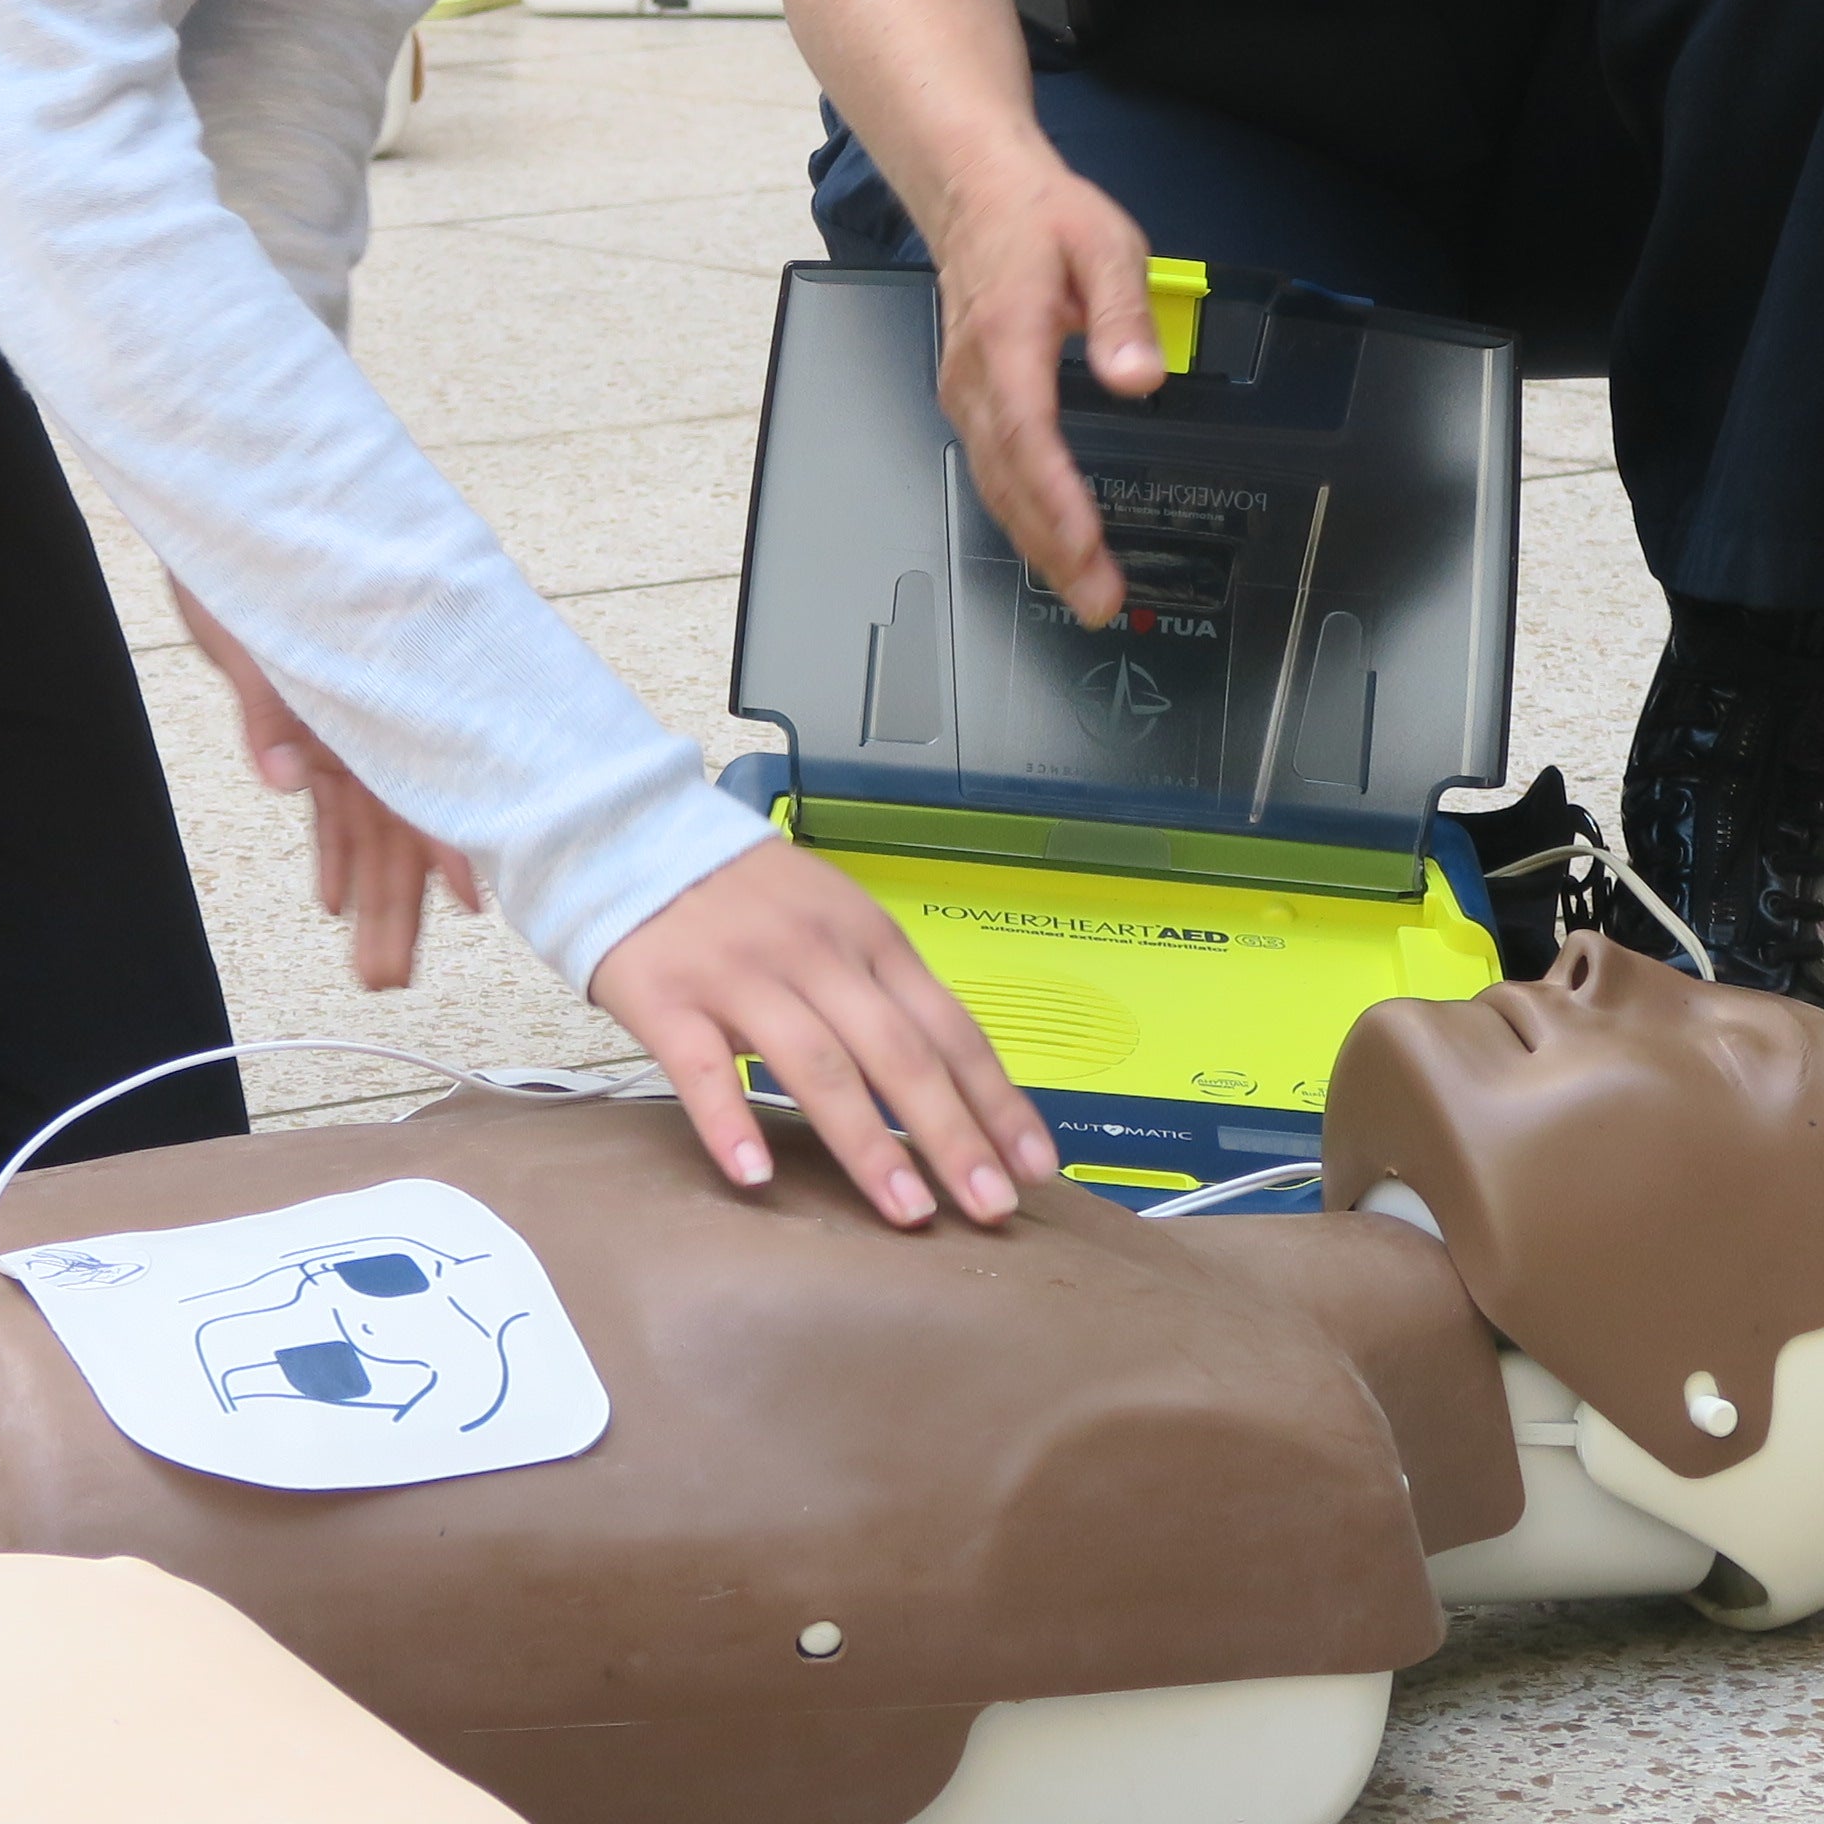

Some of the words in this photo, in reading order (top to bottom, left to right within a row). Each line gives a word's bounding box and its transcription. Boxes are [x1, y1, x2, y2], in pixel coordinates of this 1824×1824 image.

[980, 924, 1065, 939] automated
[1069, 934, 1133, 946] external
[1138, 939, 1230, 953] defibrillator
[1234, 933, 1287, 950] G3
